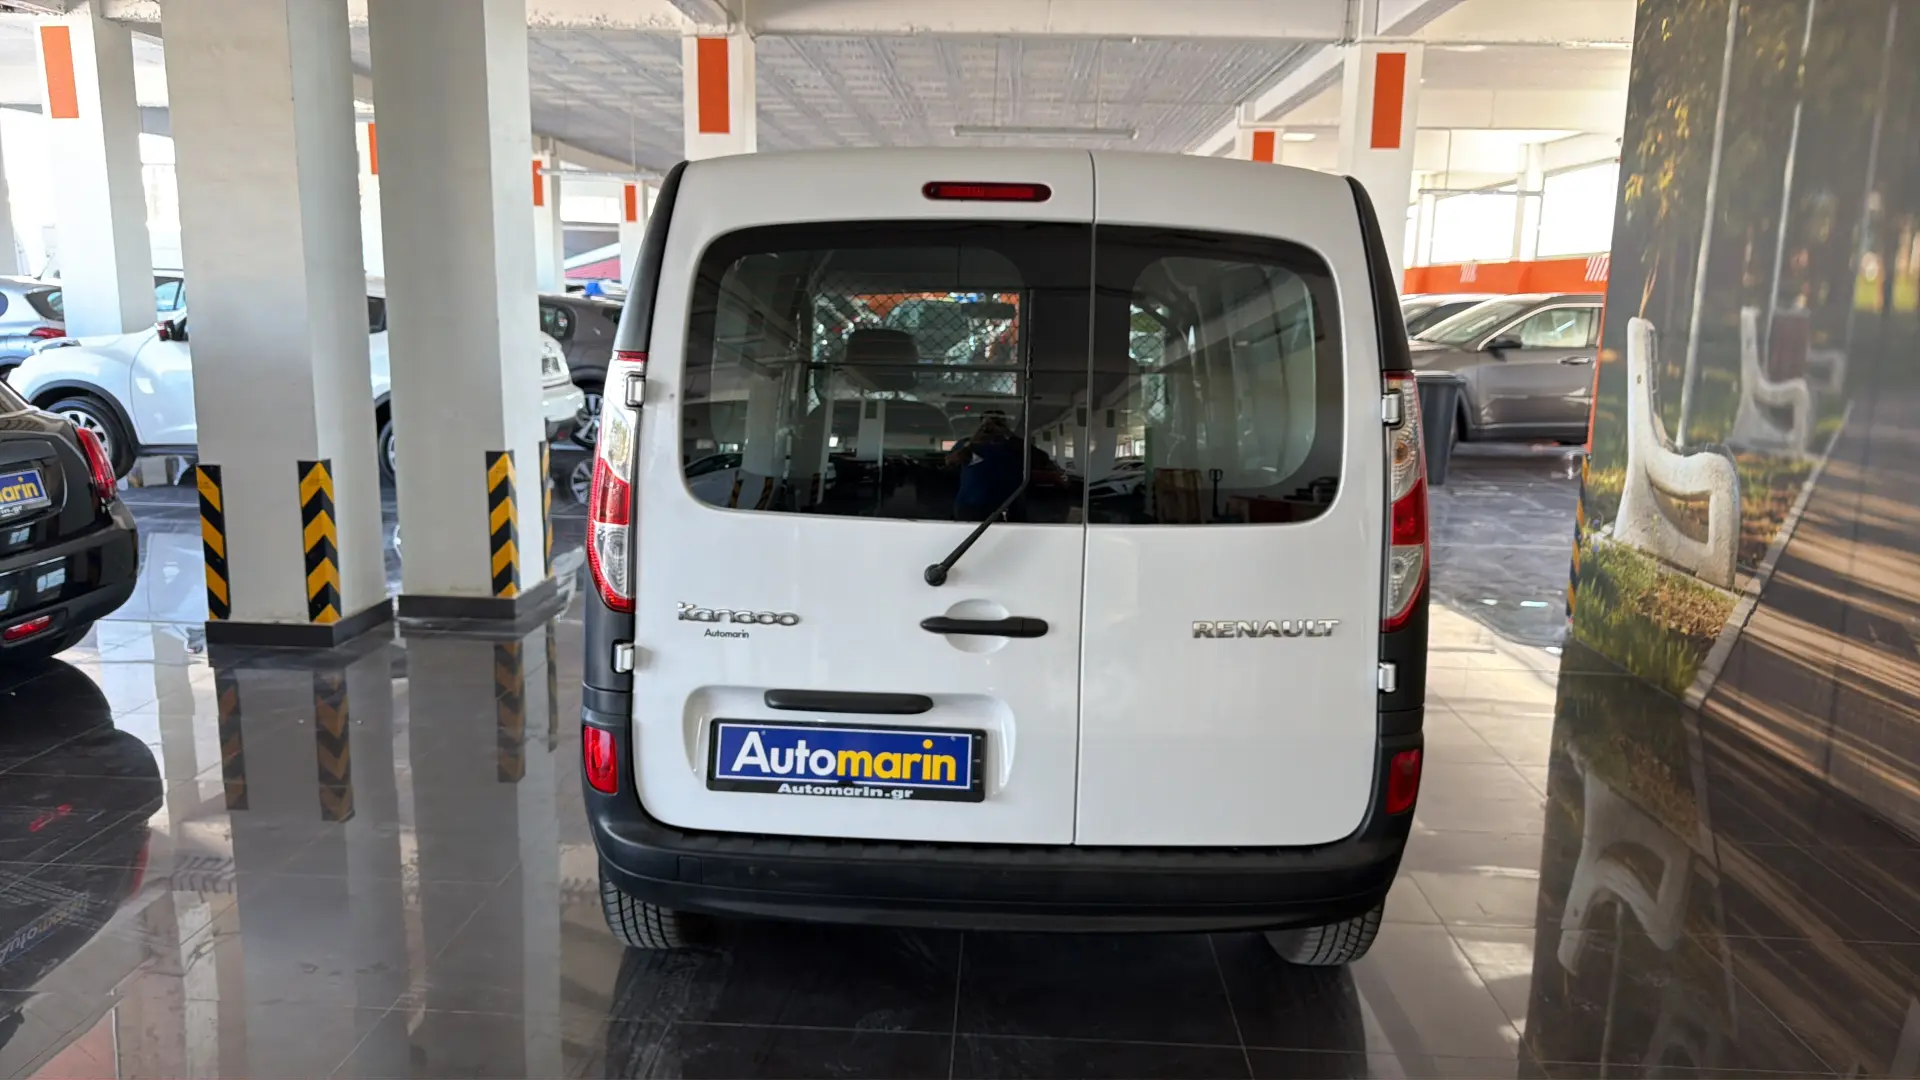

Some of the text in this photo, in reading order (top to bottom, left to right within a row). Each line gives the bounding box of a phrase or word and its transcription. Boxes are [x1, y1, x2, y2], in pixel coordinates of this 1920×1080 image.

[0, 476, 39, 502] arin
[704, 629, 749, 639] Automarin
[1192, 619, 1340, 639] RENAULT
[731, 730, 956, 781] Automarin
[777, 783, 914, 800] Automarin.gr
